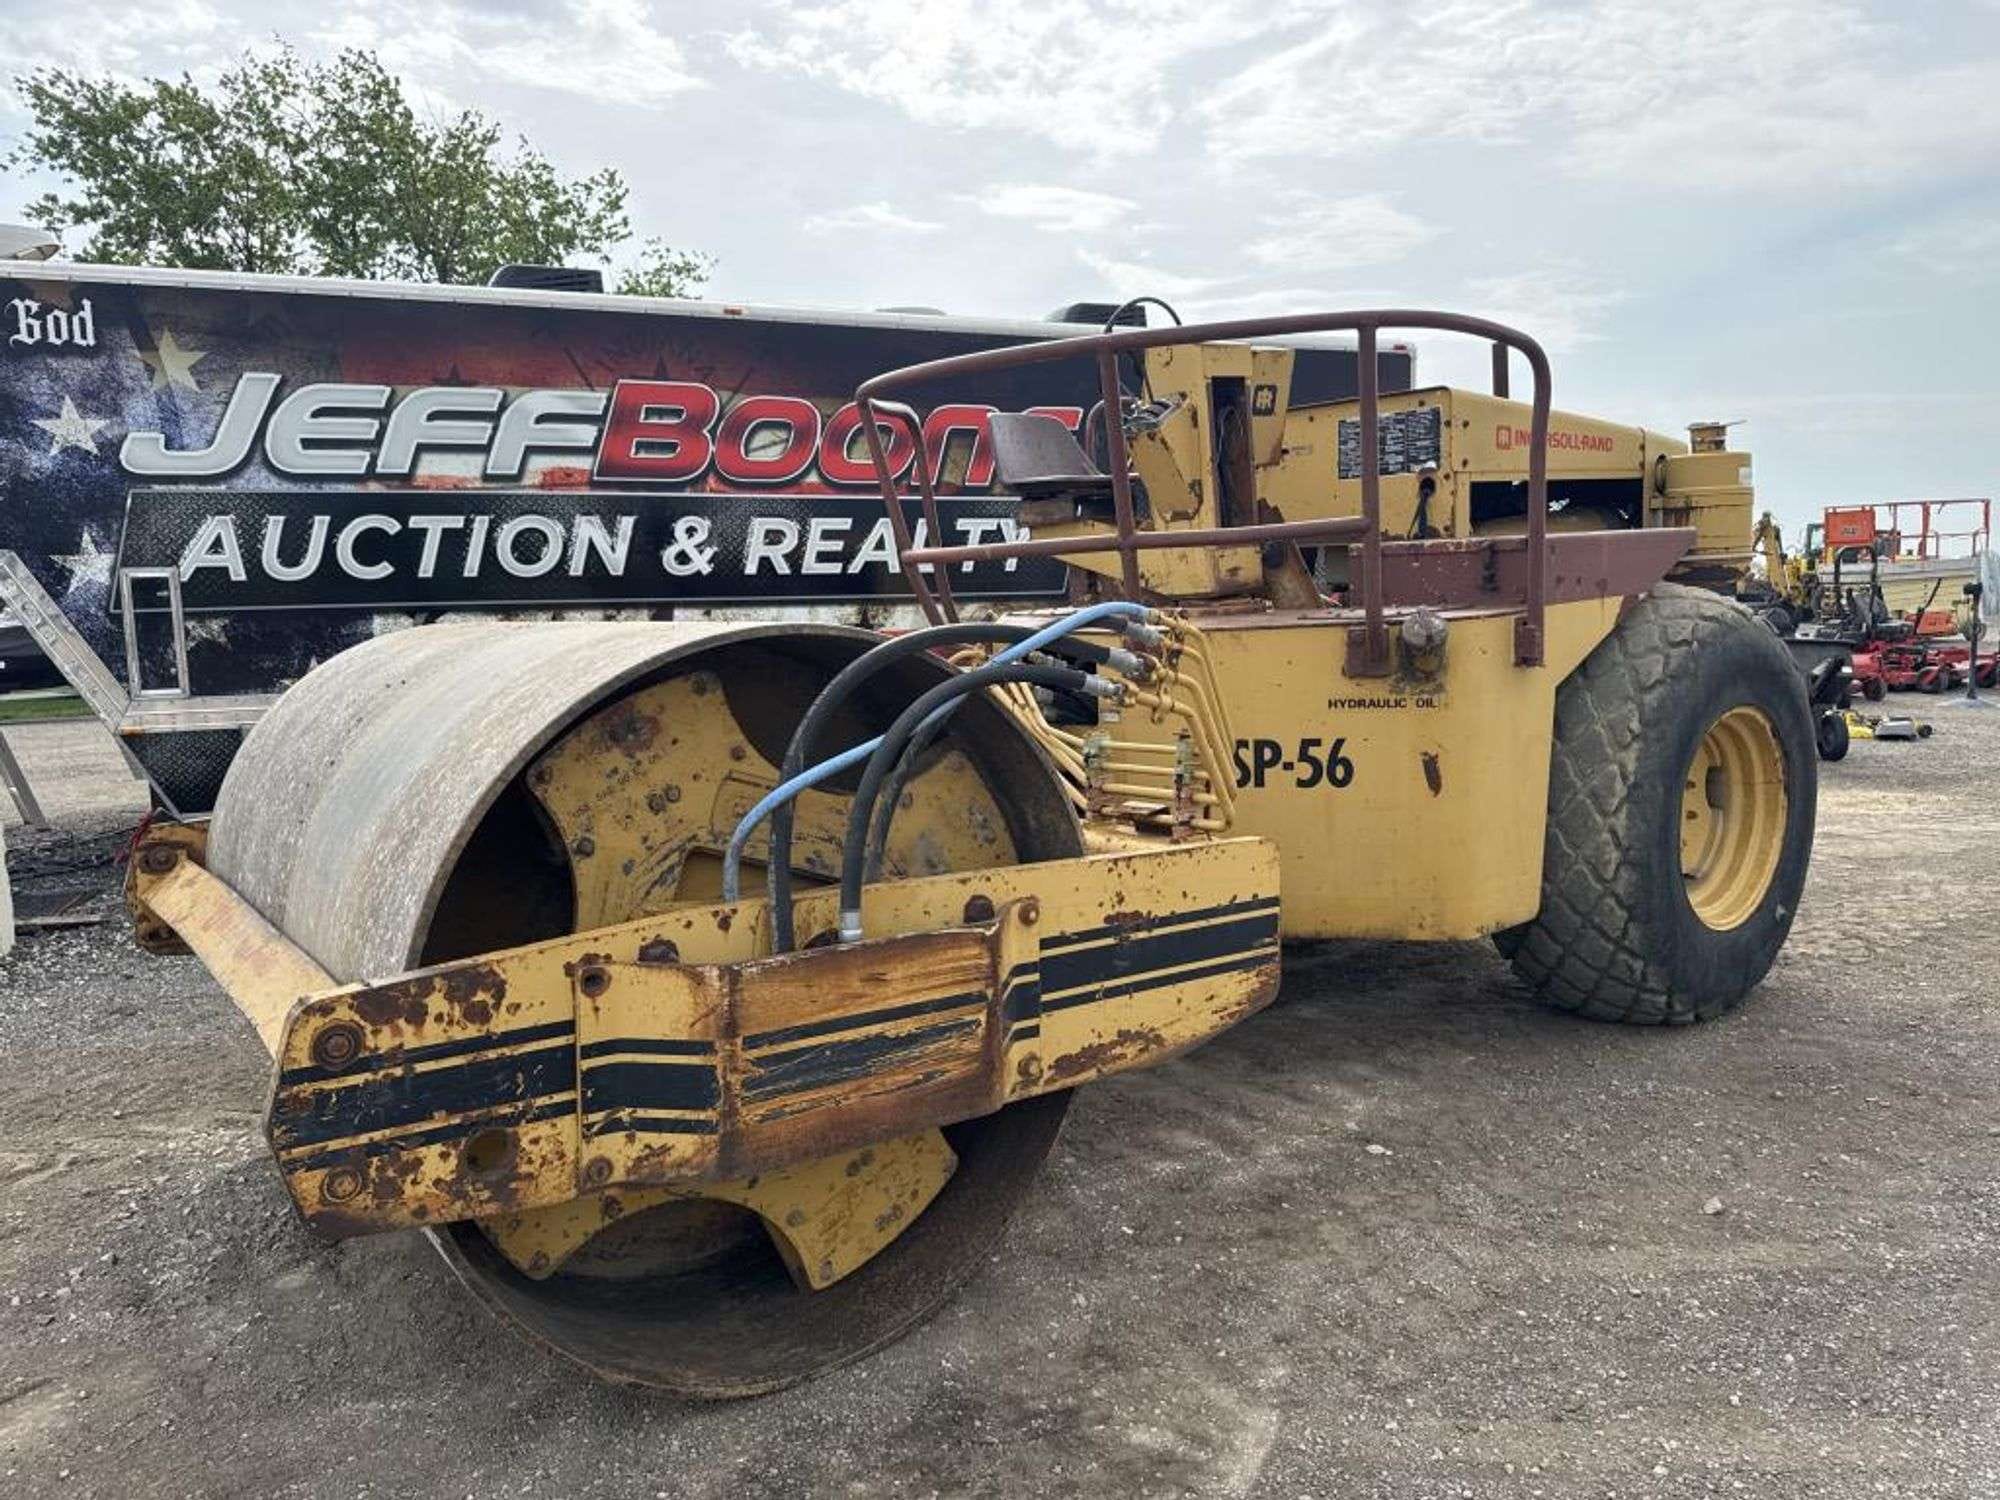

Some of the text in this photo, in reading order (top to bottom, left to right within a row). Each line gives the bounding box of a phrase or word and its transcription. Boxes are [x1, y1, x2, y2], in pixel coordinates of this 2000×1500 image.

[178, 514, 1031, 582] AUCTION & REALTY
[1328, 698, 1439, 709] HYDRAULIC OIL
[1233, 738, 1355, 789] SP-56
